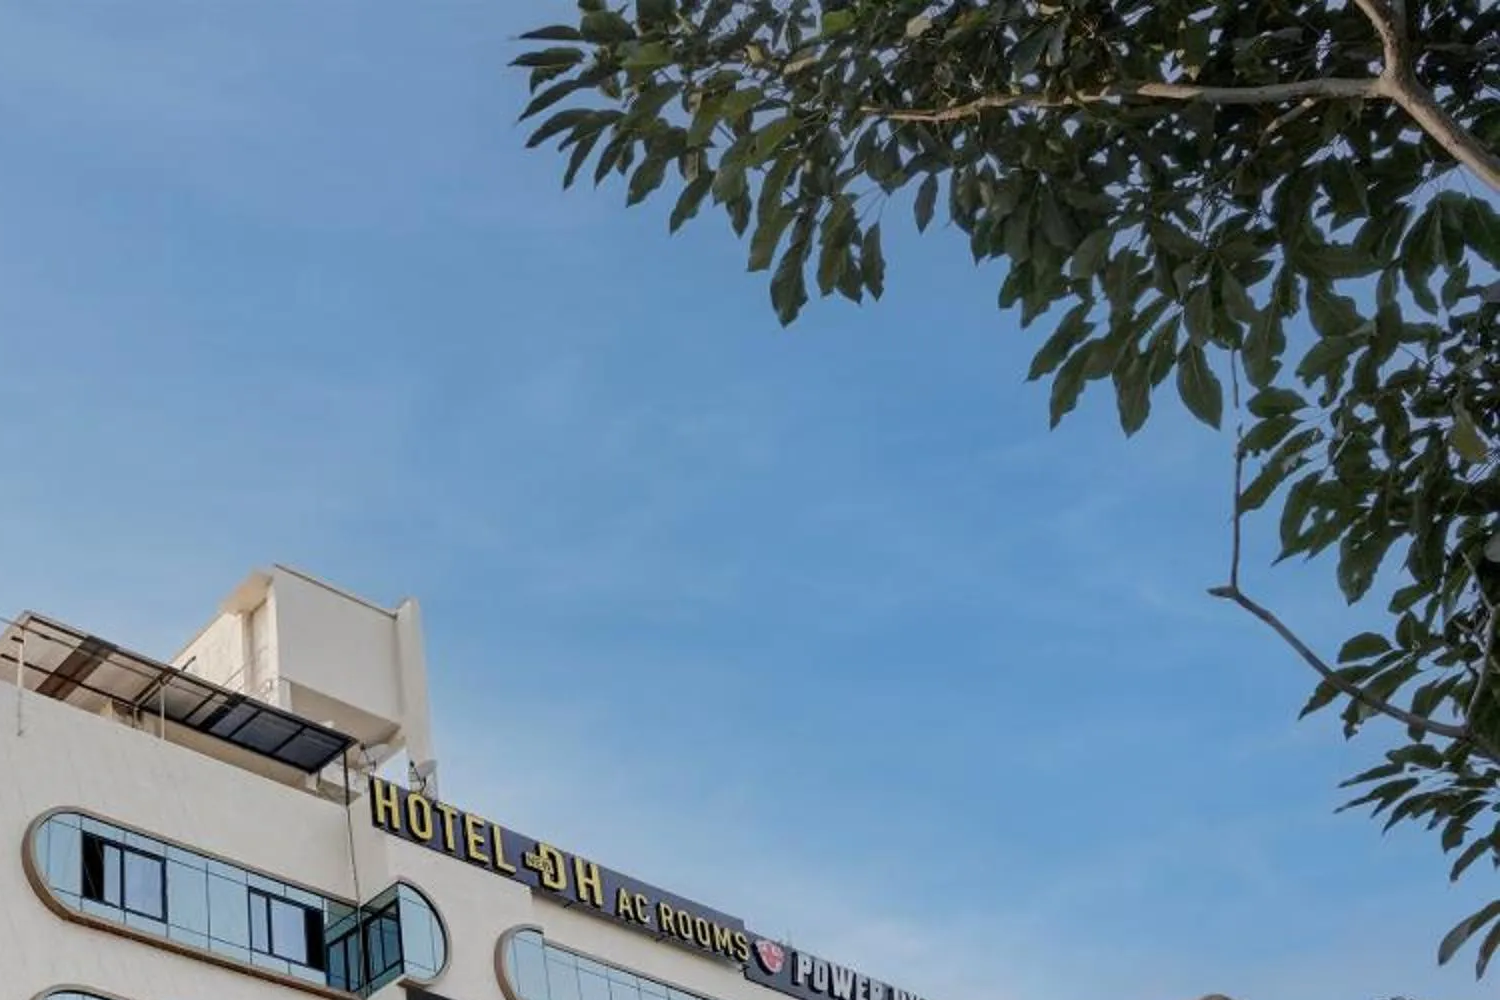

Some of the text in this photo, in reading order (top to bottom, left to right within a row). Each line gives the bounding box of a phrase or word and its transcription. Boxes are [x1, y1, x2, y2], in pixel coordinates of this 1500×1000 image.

[374, 779, 516, 875] HOTEL
[618, 887, 750, 962] AC ROOMS
